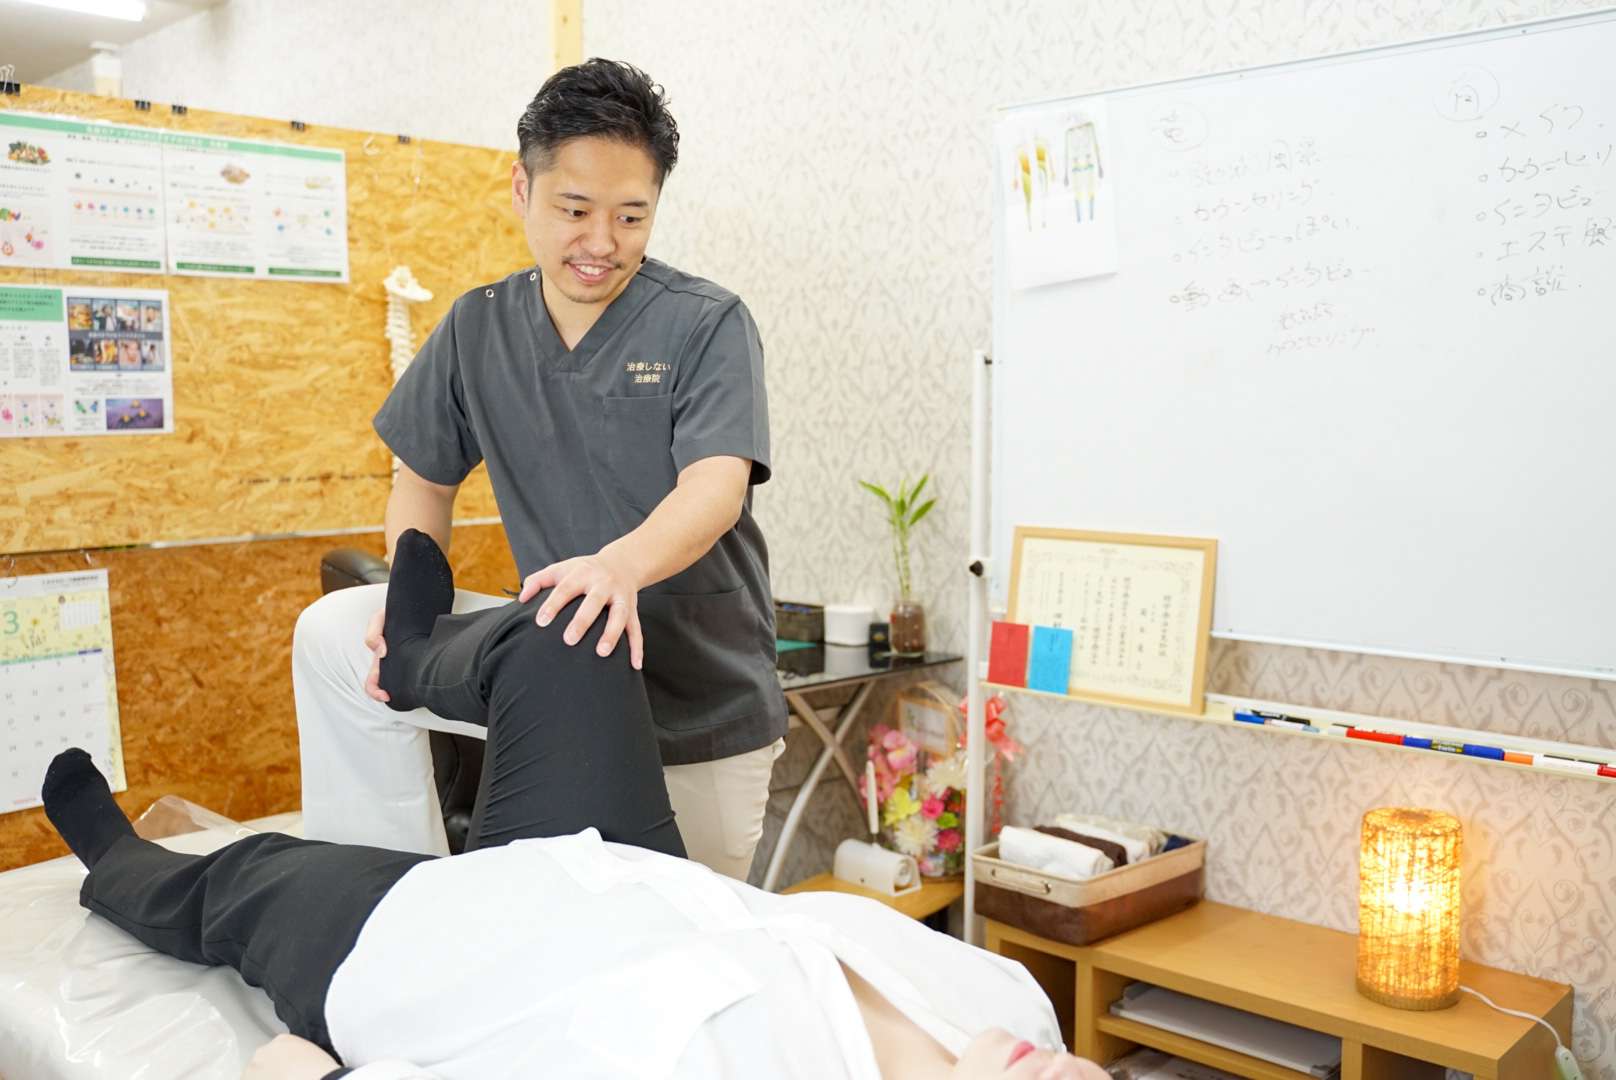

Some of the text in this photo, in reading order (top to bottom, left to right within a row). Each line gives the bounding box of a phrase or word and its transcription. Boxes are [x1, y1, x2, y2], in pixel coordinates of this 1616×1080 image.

[625, 361, 672, 371] 治療しない
[633, 373, 661, 384] 治療院
[3, 610, 19, 635] 3
